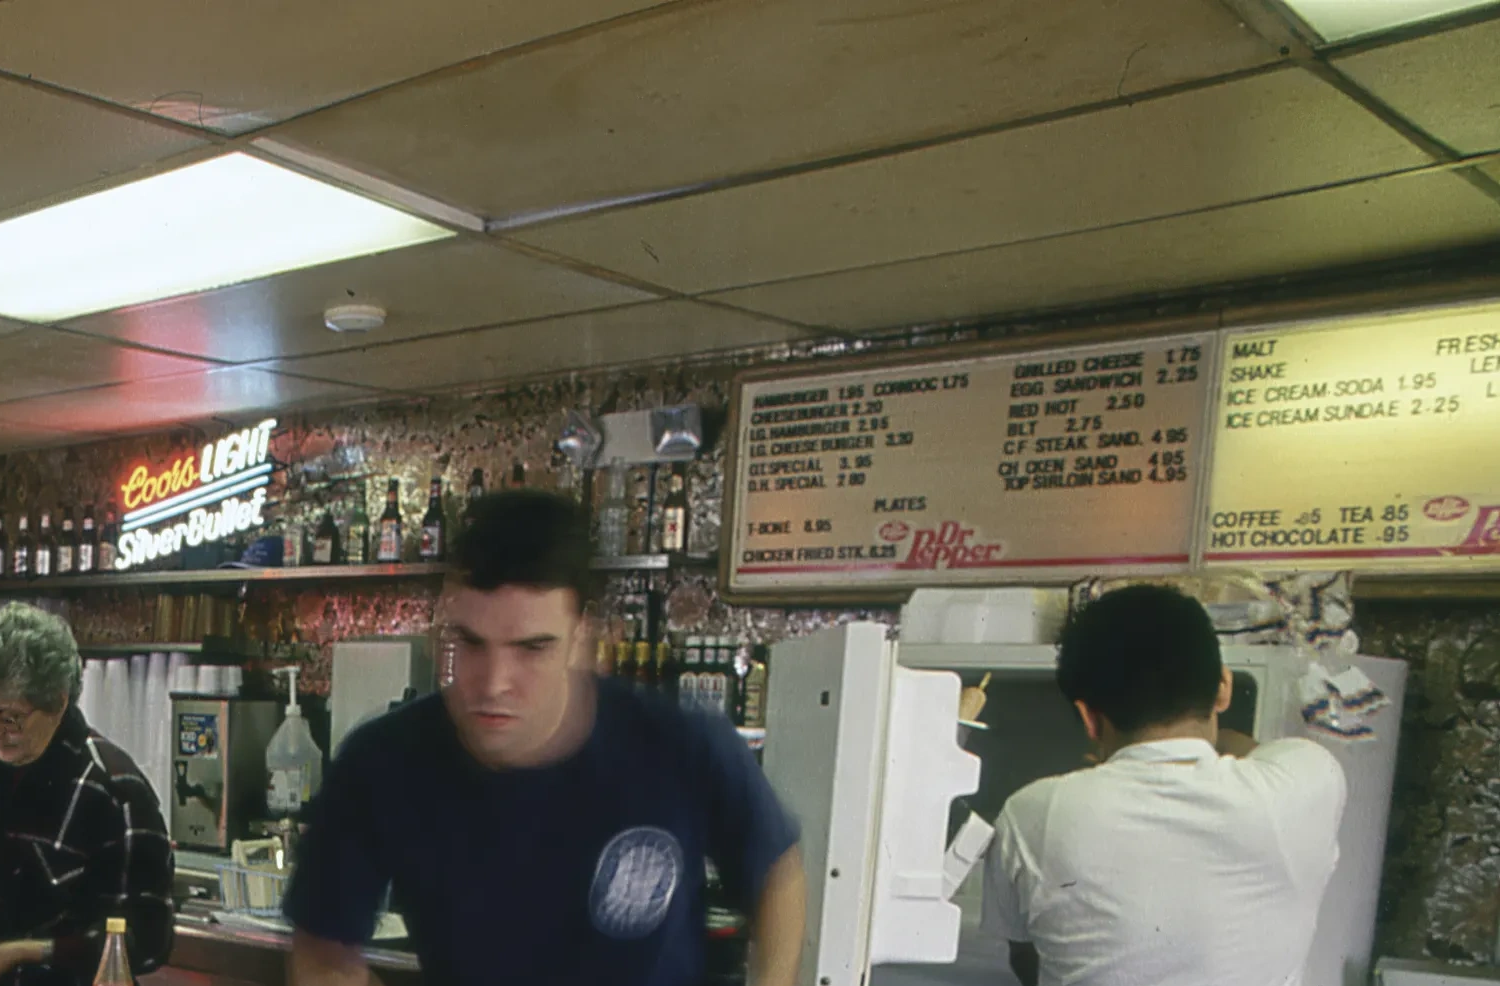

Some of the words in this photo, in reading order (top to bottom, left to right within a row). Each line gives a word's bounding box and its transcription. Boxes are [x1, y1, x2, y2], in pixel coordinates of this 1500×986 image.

[1232, 339, 1278, 360] MALT
[1229, 362, 1288, 383] SHAKE
[1010, 381, 1044, 398] EGG
[1054, 371, 1143, 394] SANDWICH
[1227, 388, 1256, 406] ICE
[1333, 377, 1385, 397] SODA
[1045, 398, 1080, 416] HOT
[1226, 411, 1254, 430] ICE
[1256, 404, 1320, 427] CREAM
[1322, 399, 1399, 421] SUNDAE
[1007, 420, 1038, 437] BLT
[1065, 415, 1103, 433] 2.75
[199, 418, 277, 483] LIGHT
[1035, 435, 1089, 453] STEAK
[121, 455, 201, 509] Coors
[874, 496, 928, 513] PLATES
[1212, 509, 1283, 529] COFFEE
[1339, 506, 1374, 524] TEA
[937, 519, 976, 548] Dr
[1211, 529, 1248, 549] HOT
[1249, 526, 1366, 548] CHOCOLATE
[905, 529, 1002, 570] Pepper
